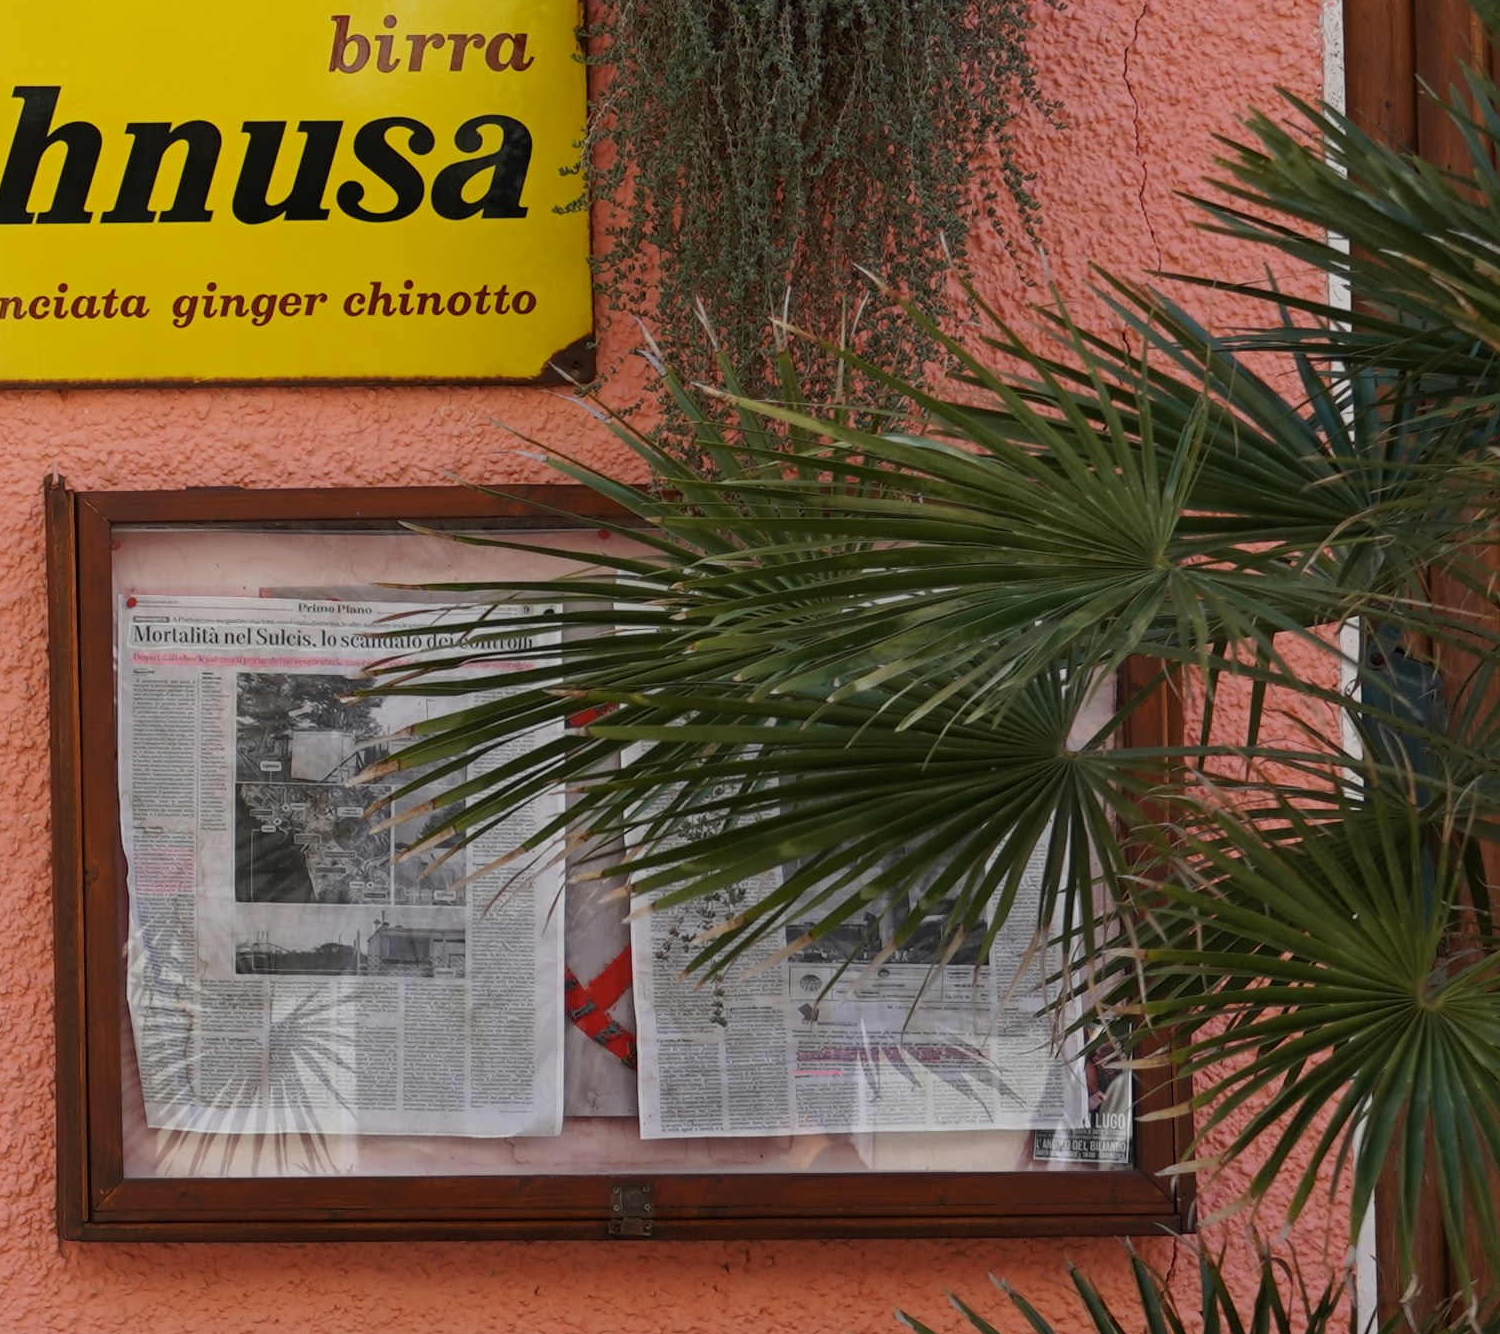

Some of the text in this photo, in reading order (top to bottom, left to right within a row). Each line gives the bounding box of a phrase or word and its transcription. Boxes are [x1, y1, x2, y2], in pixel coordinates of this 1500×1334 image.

[328, 14, 535, 74] birra
[171, 282, 328, 329] ginger
[342, 280, 538, 319] chinotto
[298, 603, 335, 613] Primo
[337, 604, 372, 614] Piano
[133, 624, 219, 644] Mortalità
[224, 627, 252, 645] nel
[321, 629, 337, 648] lo
[1095, 1113, 1126, 1129] LUGO
[1072, 1140, 1088, 1151] DEL
